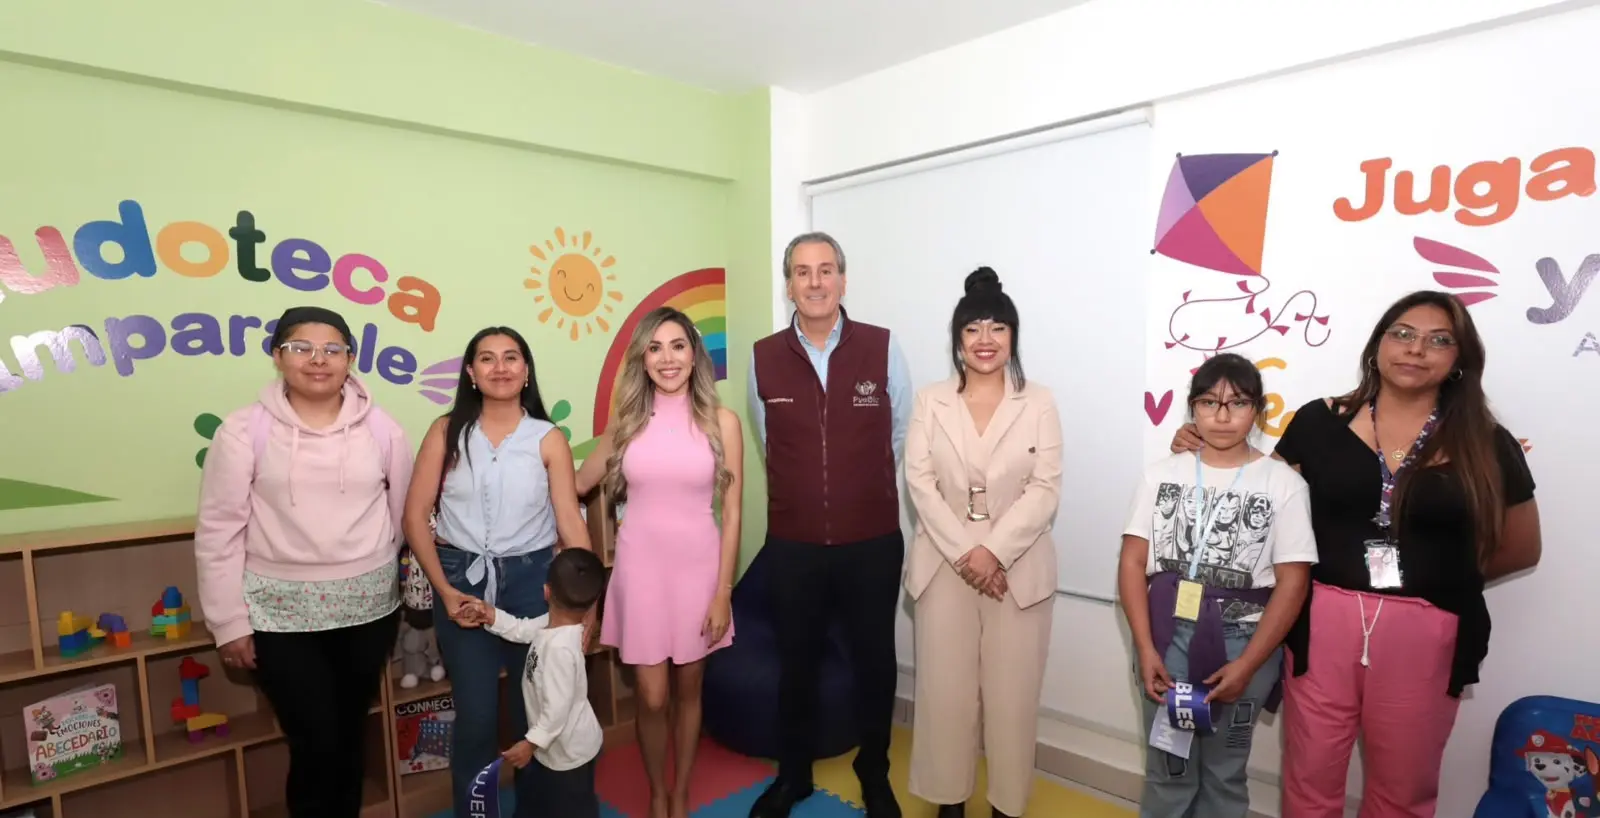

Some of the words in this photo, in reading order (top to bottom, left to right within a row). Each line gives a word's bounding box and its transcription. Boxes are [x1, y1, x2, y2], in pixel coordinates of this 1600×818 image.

[1333, 147, 1597, 226] Juga
[0, 199, 442, 333] udoteca
[56, 719, 101, 737] EMOCIONES
[1175, 681, 1196, 730] BLES
[36, 725, 117, 762] ABECEDARIO
